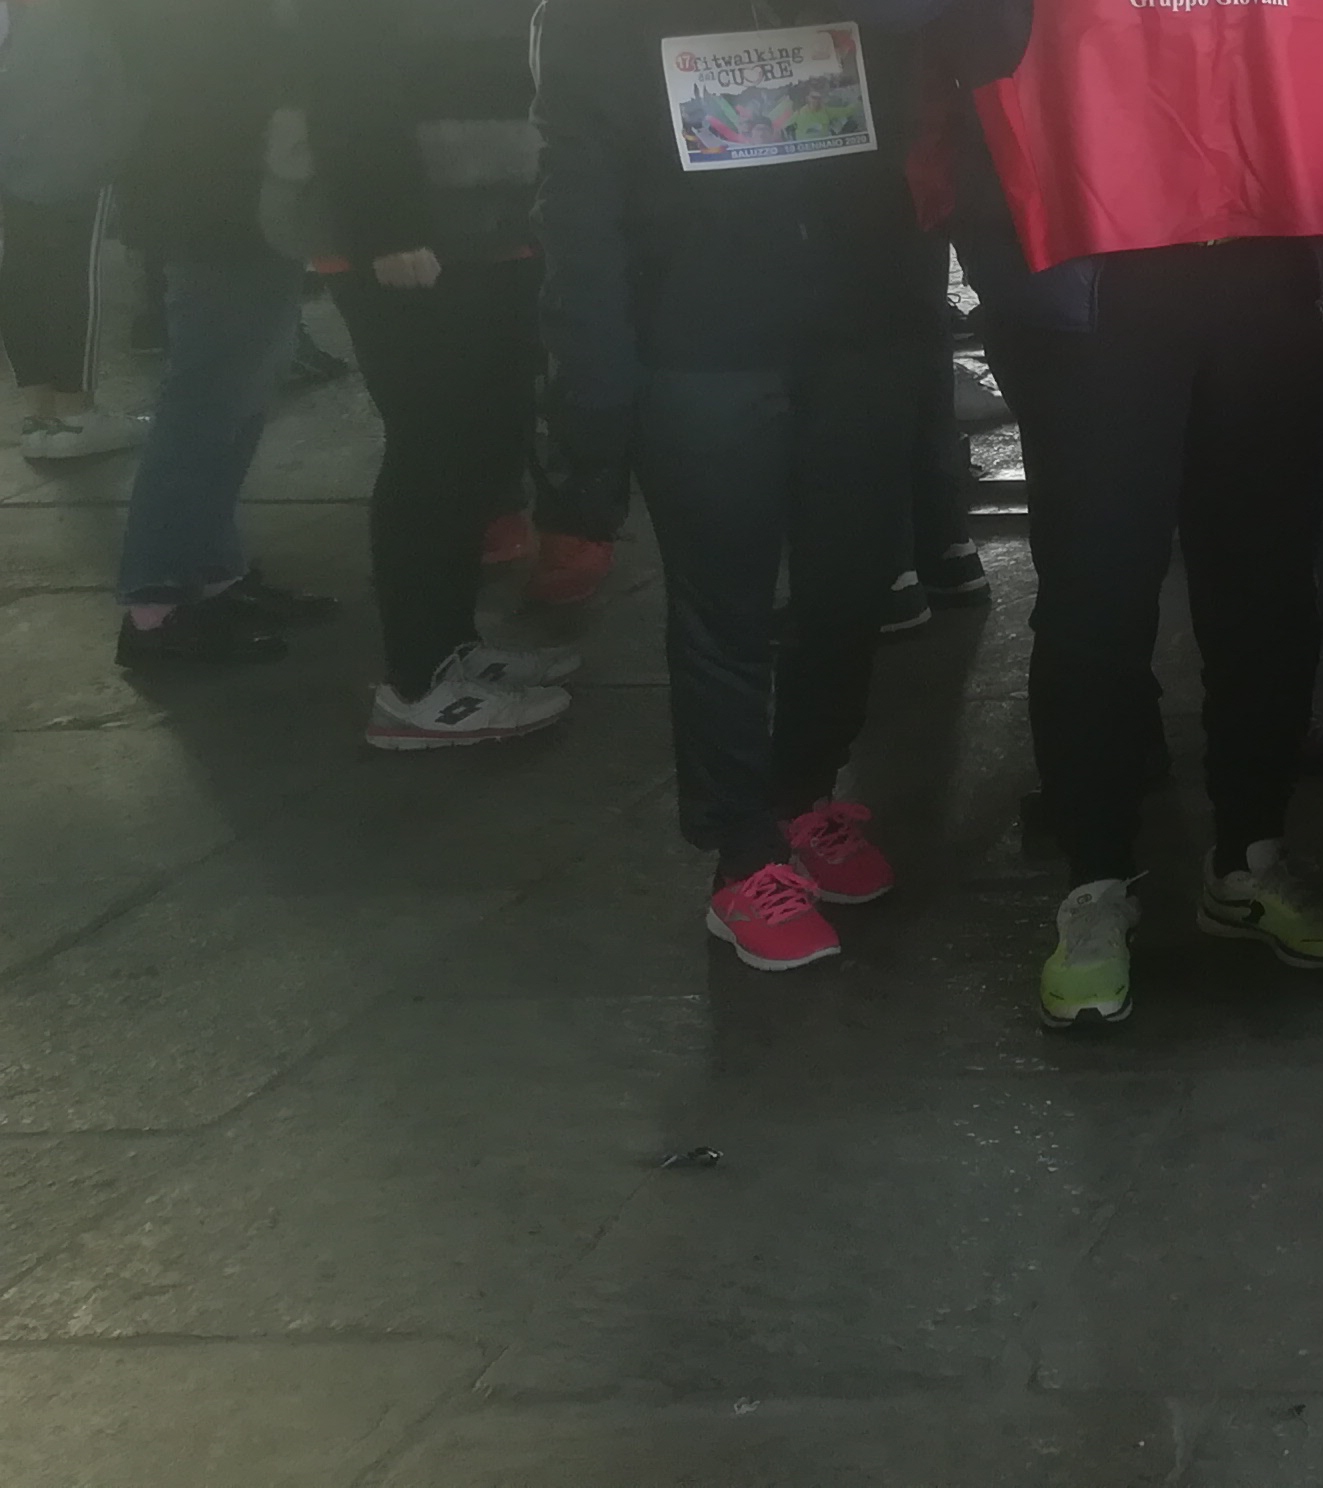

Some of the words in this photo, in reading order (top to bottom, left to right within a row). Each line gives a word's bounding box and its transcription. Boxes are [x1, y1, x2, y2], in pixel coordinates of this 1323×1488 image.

[693, 46, 804, 72] fitwalking
[698, 69, 716, 81] del
[731, 146, 778, 159] SALUZZO
[785, 144, 796, 153] 19
[797, 138, 843, 152] GENNAIO
[845, 135, 867, 145] 2020
